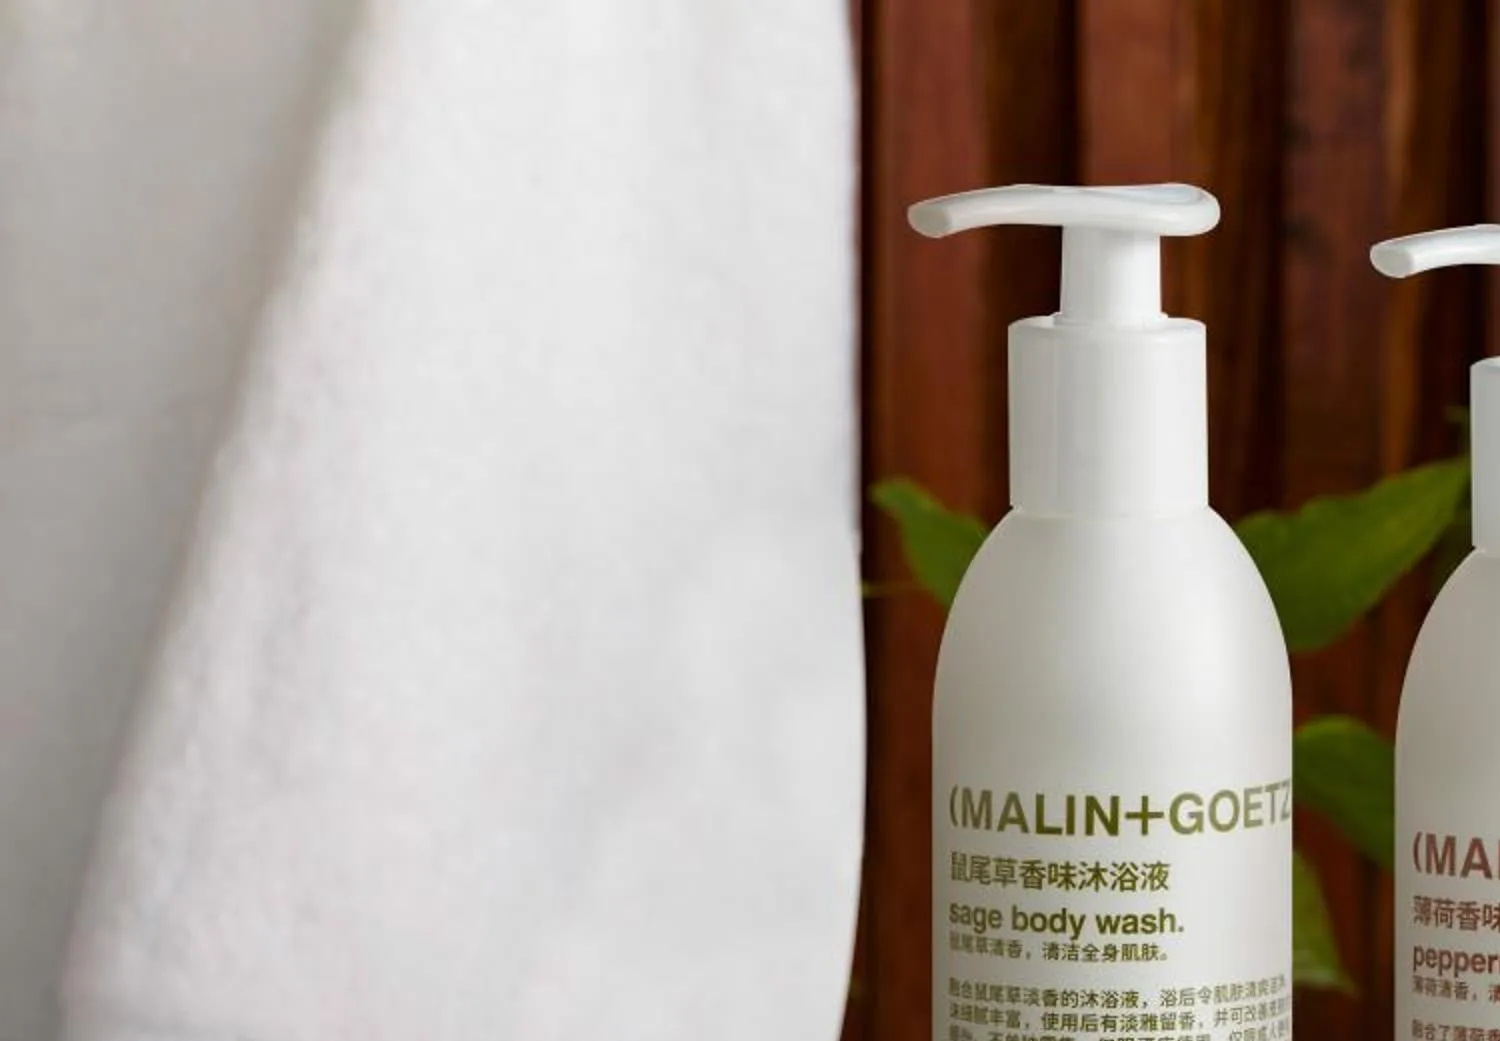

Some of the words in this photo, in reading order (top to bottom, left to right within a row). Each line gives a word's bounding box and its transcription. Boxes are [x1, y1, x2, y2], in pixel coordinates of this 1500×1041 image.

[951, 852, 1170, 892] 鼠尾草香味沐浴液
[949, 902, 1003, 934] sage
[1012, 905, 1086, 939] body
[1095, 908, 1184, 935] wash.
